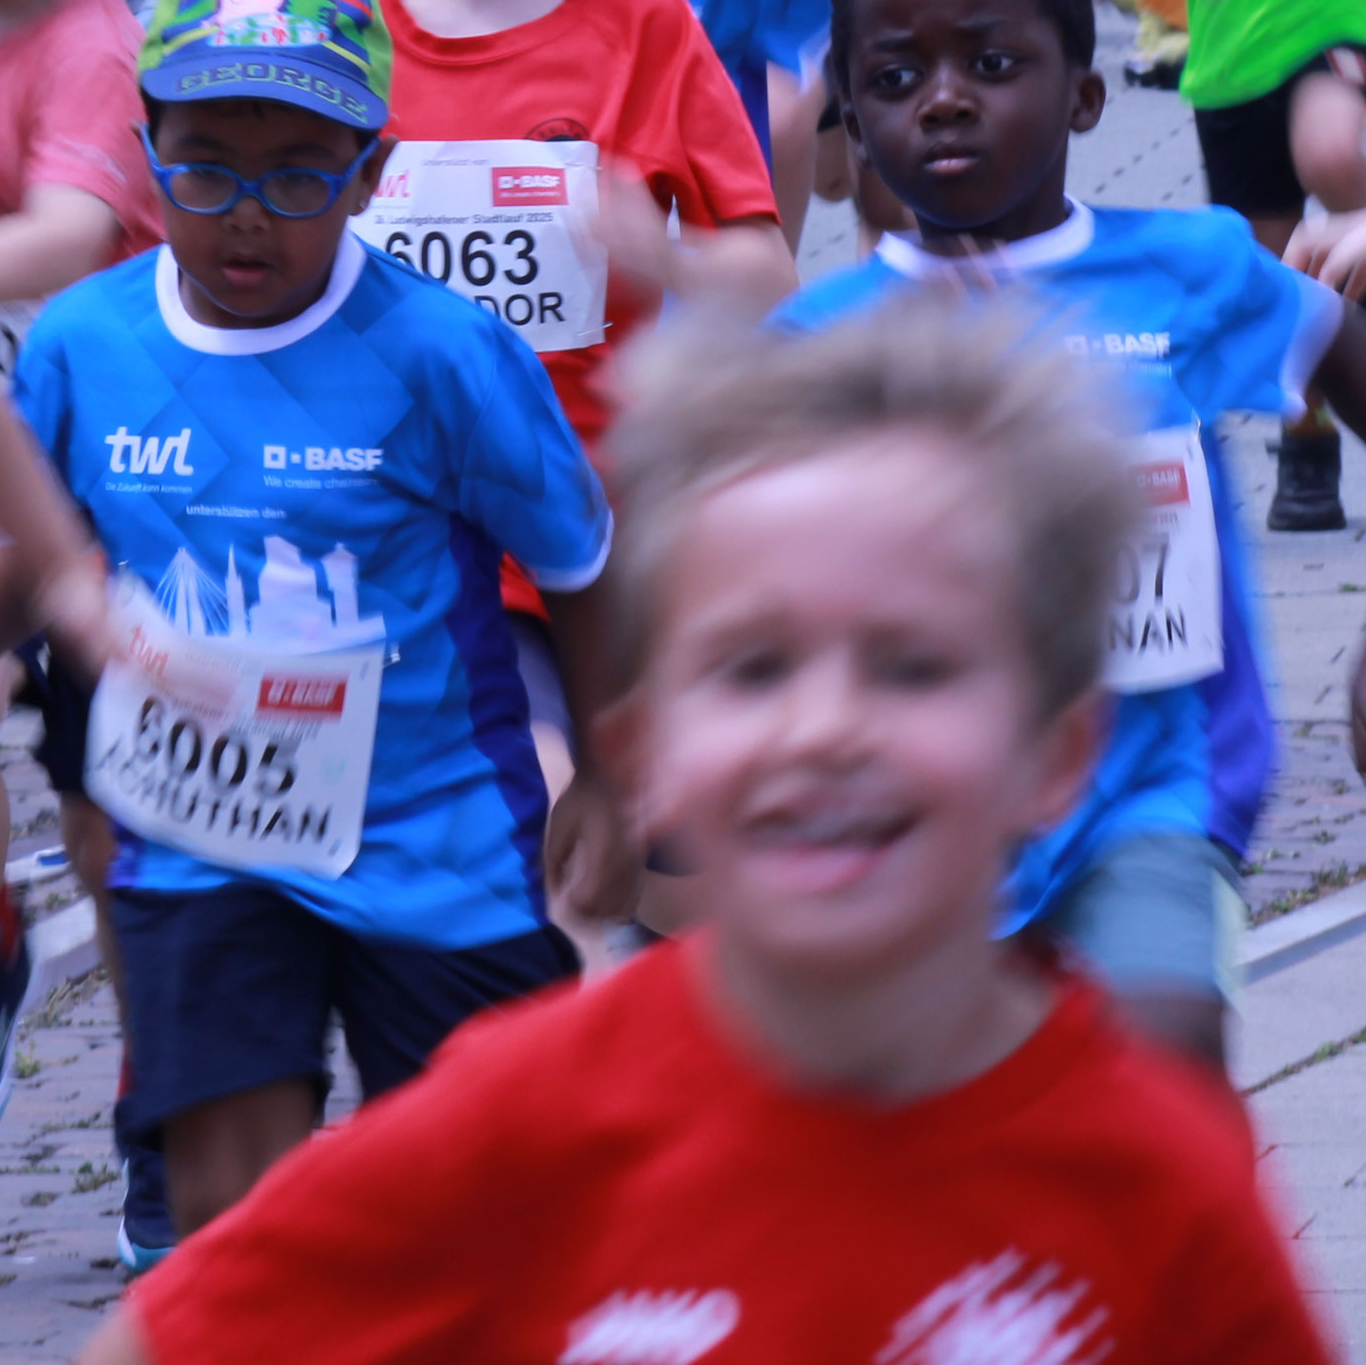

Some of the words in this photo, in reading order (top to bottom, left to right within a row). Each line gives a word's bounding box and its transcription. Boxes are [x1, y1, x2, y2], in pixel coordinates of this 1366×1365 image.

[176, 61, 368, 124] GEORGE
[385, 229, 539, 287] 6063
[104, 426, 194, 476] twl
[304, 446, 384, 472] BASF
